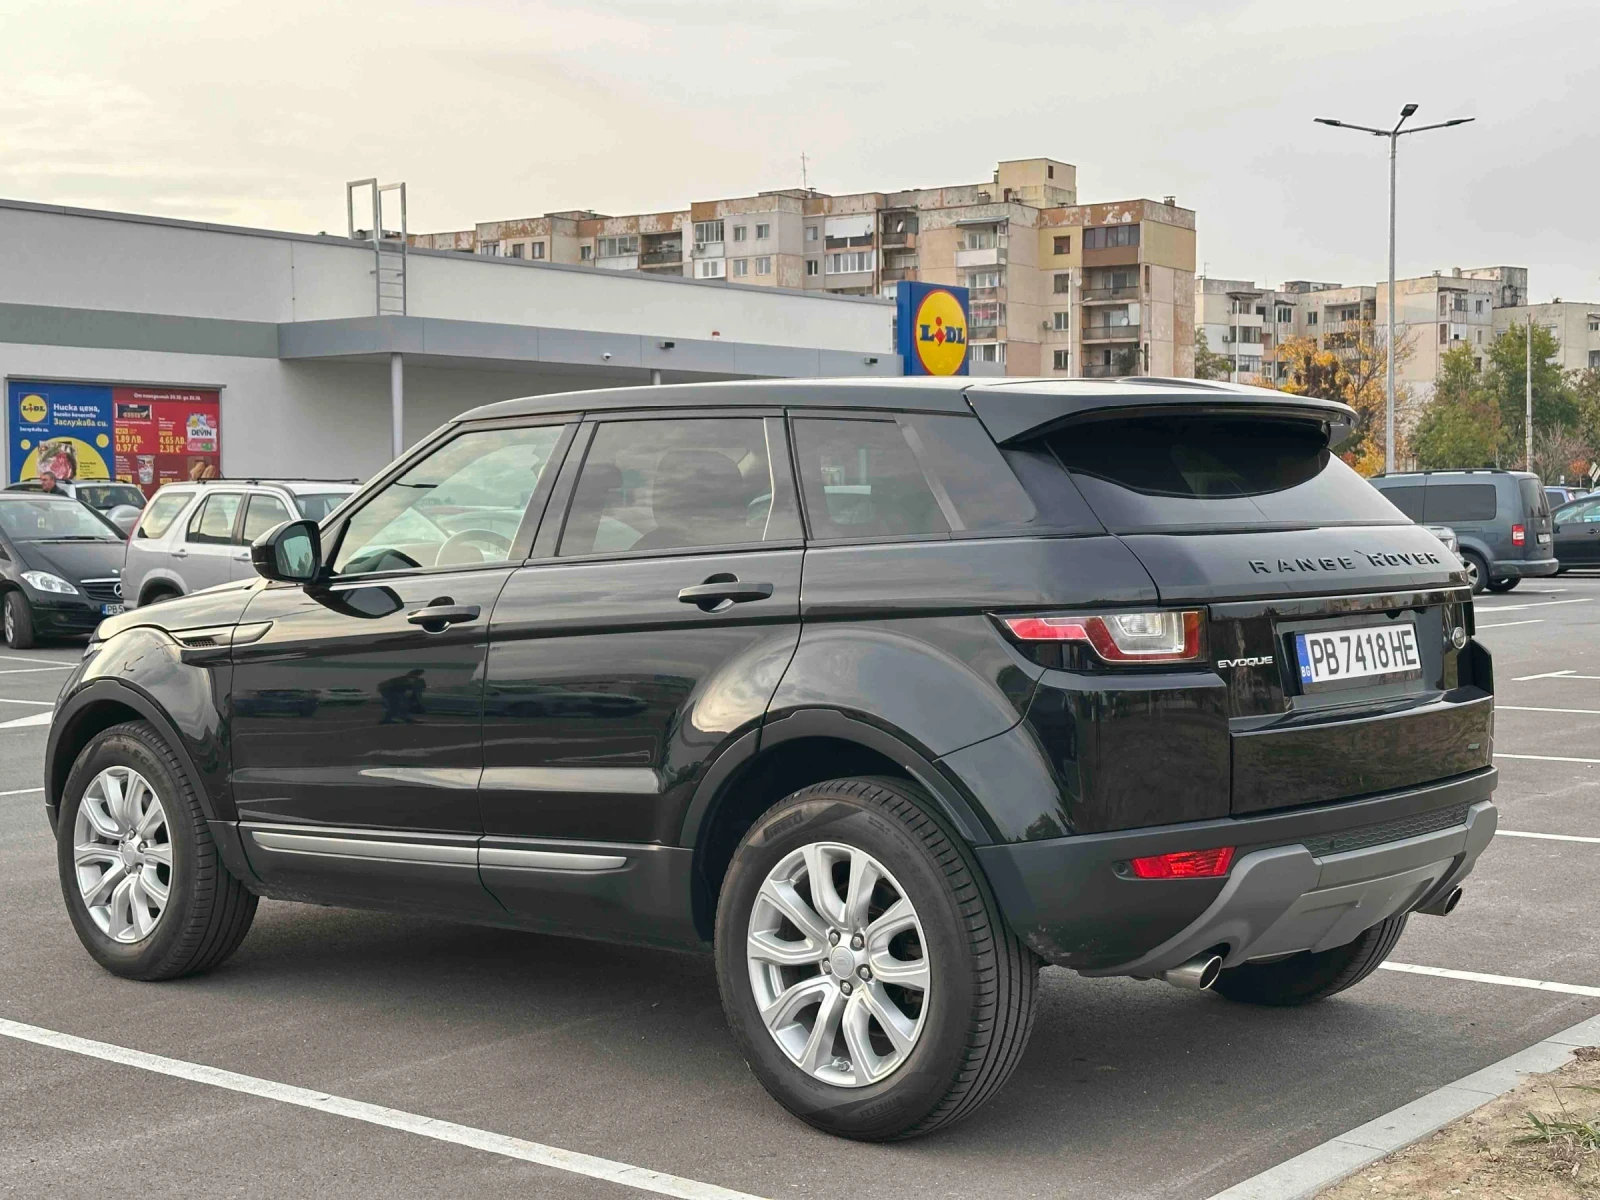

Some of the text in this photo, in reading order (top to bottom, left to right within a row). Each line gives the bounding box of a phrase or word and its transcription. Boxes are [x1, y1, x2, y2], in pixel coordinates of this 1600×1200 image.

[919, 317, 965, 346] LIDL
[22, 403, 45, 412] LIDL
[79, 405, 100, 413] цена,
[53, 418, 96, 427] Заслужава
[191, 427, 212, 436] DEVIN
[115, 434, 130, 443] 1.89
[159, 436, 174, 445] 4.65
[115, 443, 131, 452] 0.97
[159, 444, 174, 453] 2.38
[1248, 551, 1441, 574] RANGE ROVER
[1217, 655, 1273, 669] EVOQUE
[1300, 665, 1311, 677] BG
